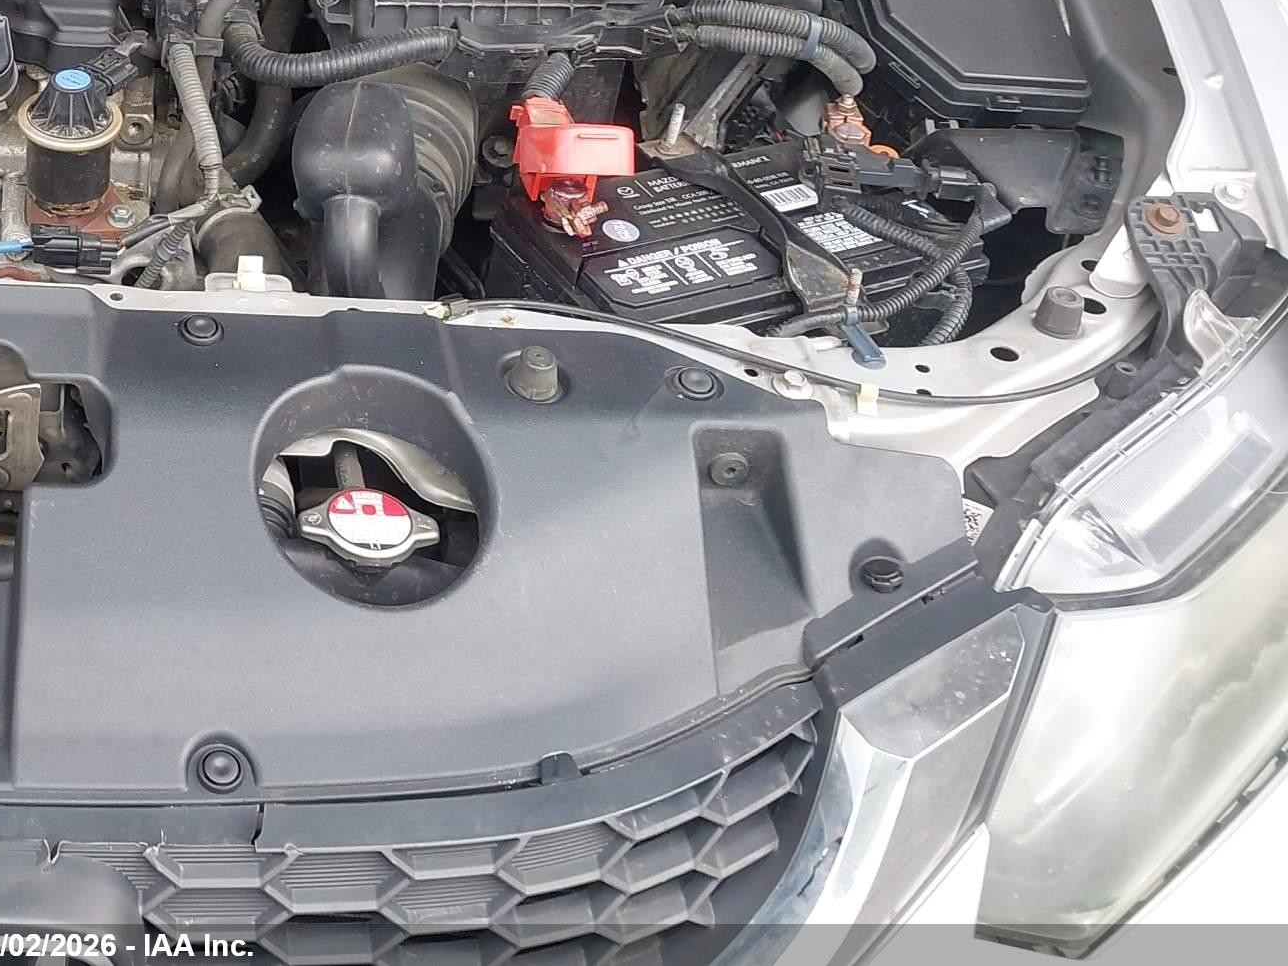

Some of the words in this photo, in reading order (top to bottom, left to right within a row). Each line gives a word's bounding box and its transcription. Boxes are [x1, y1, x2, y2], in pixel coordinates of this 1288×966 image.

[731, 155, 771, 168] RMANCE
[647, 176, 680, 187] MAZD
[626, 249, 674, 266] DANGER
[678, 237, 723, 253] POISON
